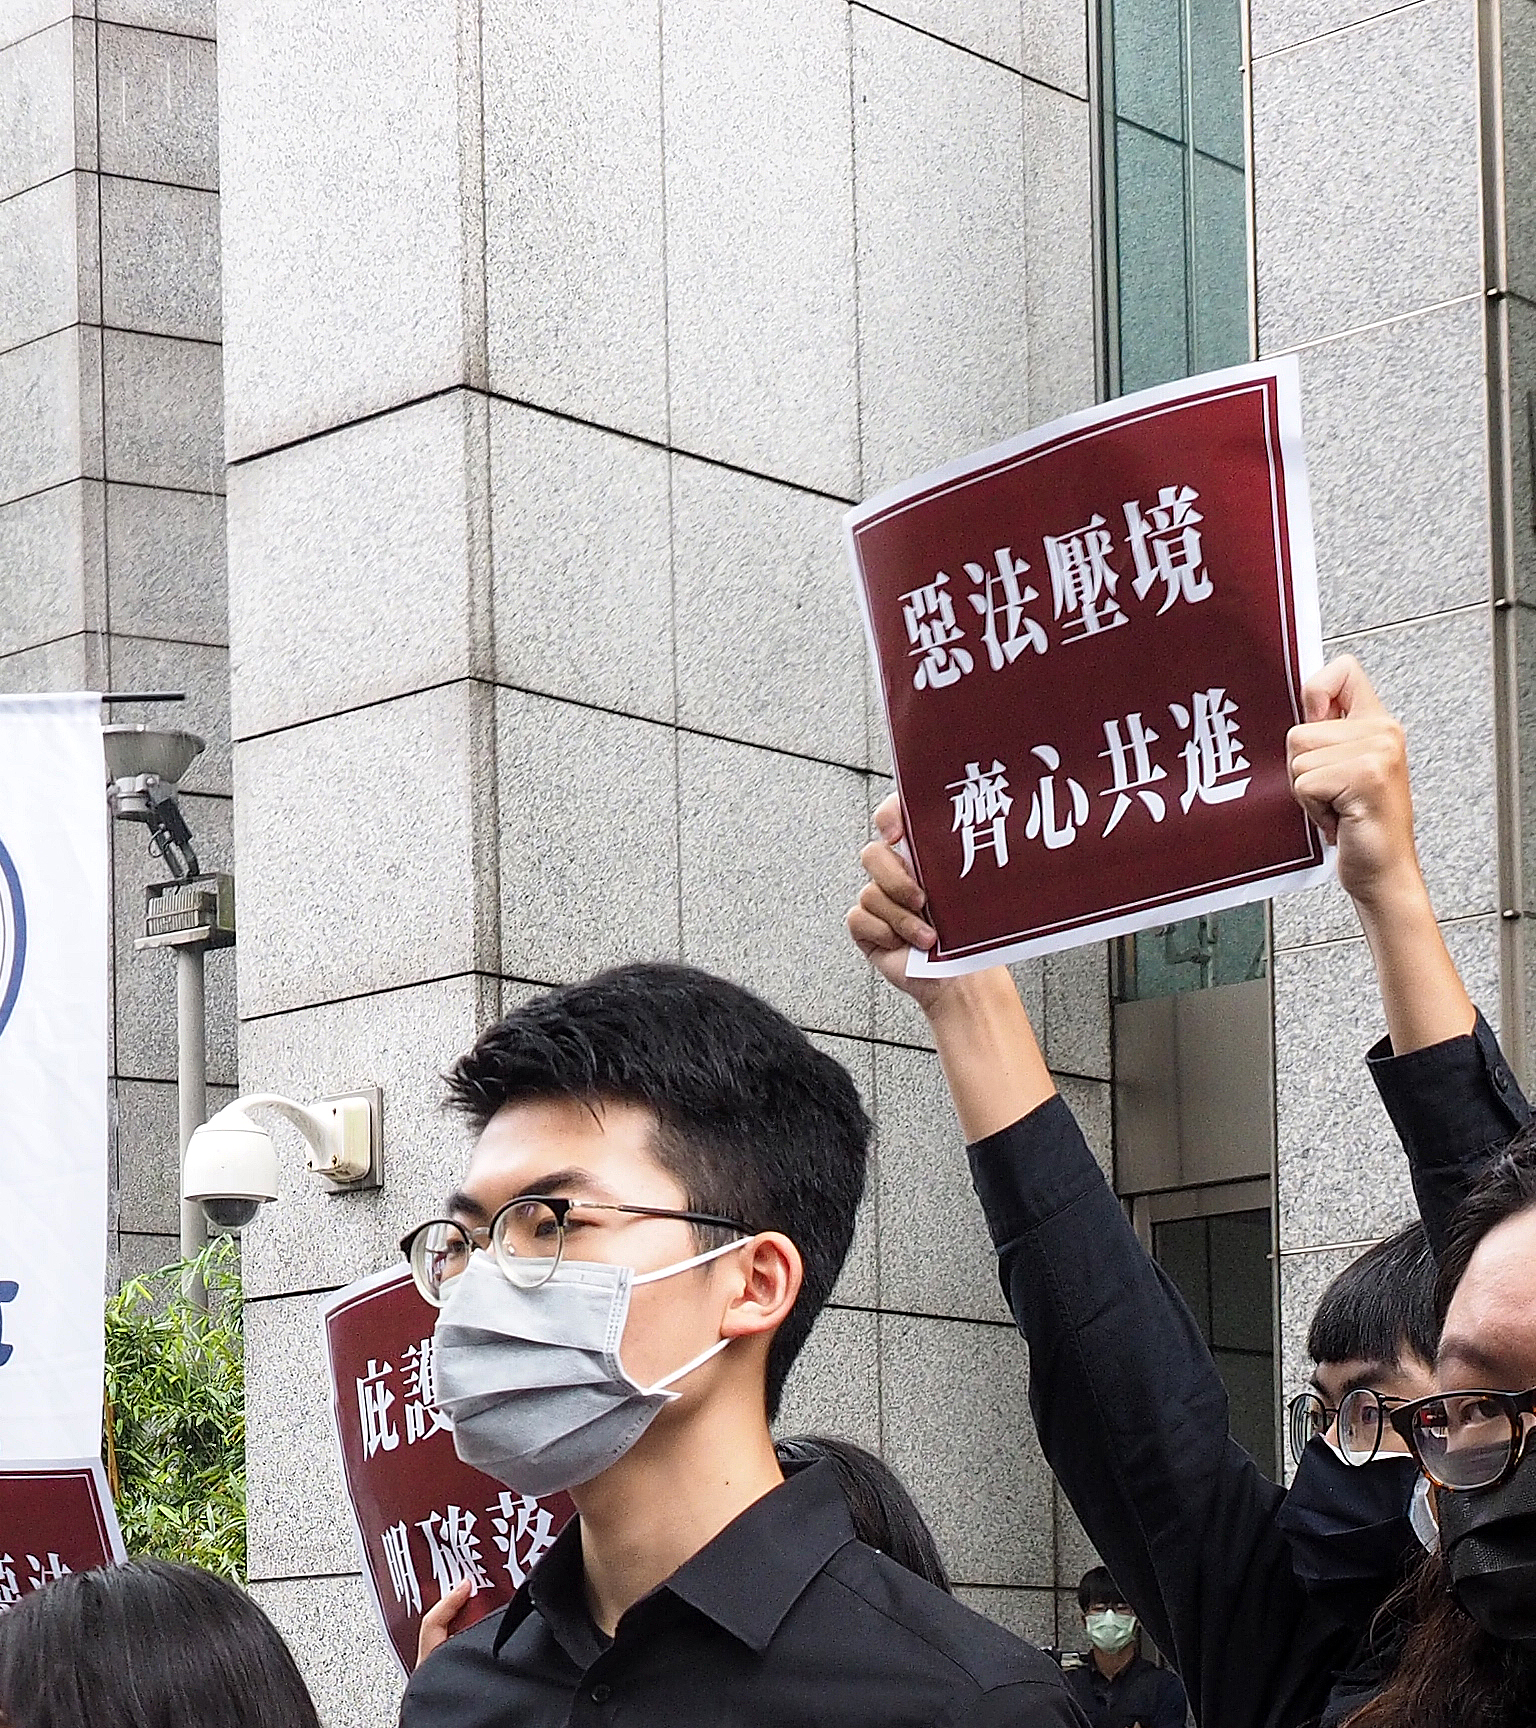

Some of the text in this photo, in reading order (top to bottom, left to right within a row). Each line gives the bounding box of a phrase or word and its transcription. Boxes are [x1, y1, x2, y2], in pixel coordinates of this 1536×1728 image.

[897, 484, 1215, 691] 惡法壓境
[944, 687, 1253, 879] 齊心共進
